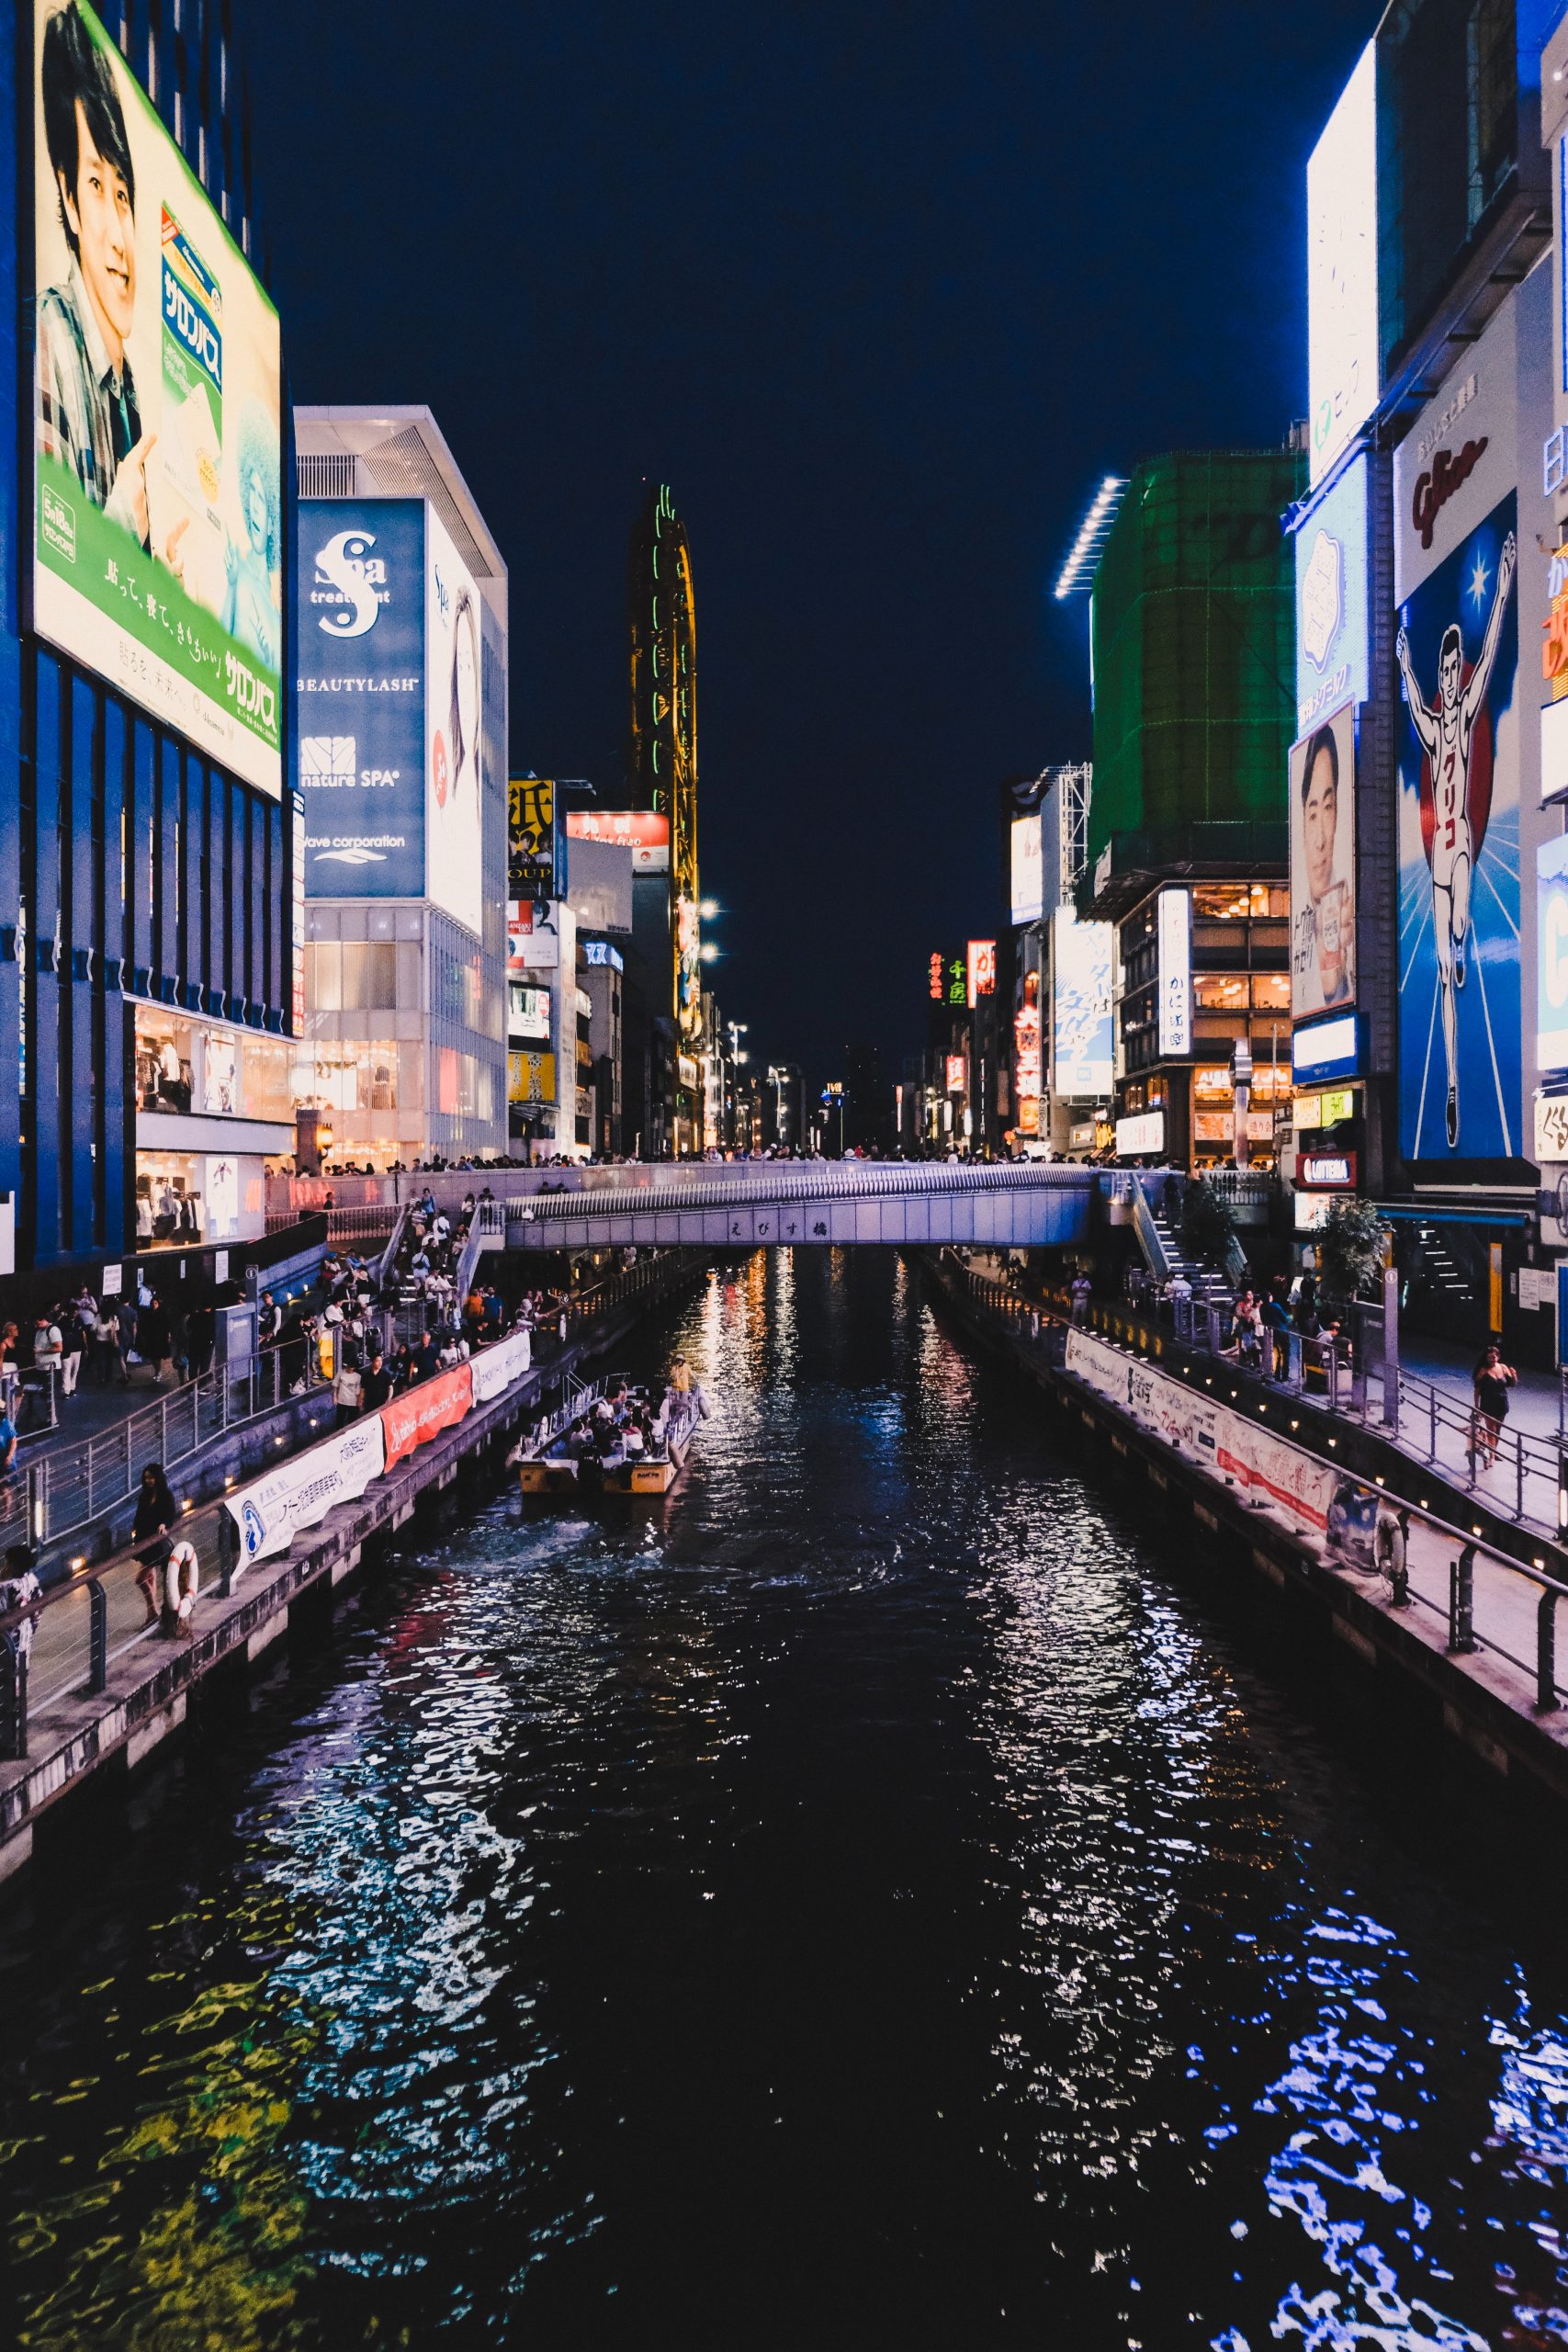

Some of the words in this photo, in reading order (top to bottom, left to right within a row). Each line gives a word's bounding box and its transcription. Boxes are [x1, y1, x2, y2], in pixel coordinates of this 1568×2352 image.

[165, 269, 222, 386] サロンパス
[310, 590, 390, 604] treatnt
[225, 650, 277, 733] サロンパス
[297, 678, 415, 693] BEAUTYLASH
[300, 773, 356, 788] nature
[360, 770, 396, 787] SPA
[1442, 745, 1458, 851] グリコ
[332, 835, 405, 849] corporation
[949, 960, 966, 999] 千房
[1169, 976, 1185, 1046] かに道楽
[731, 1221, 828, 1237] えびす橋
